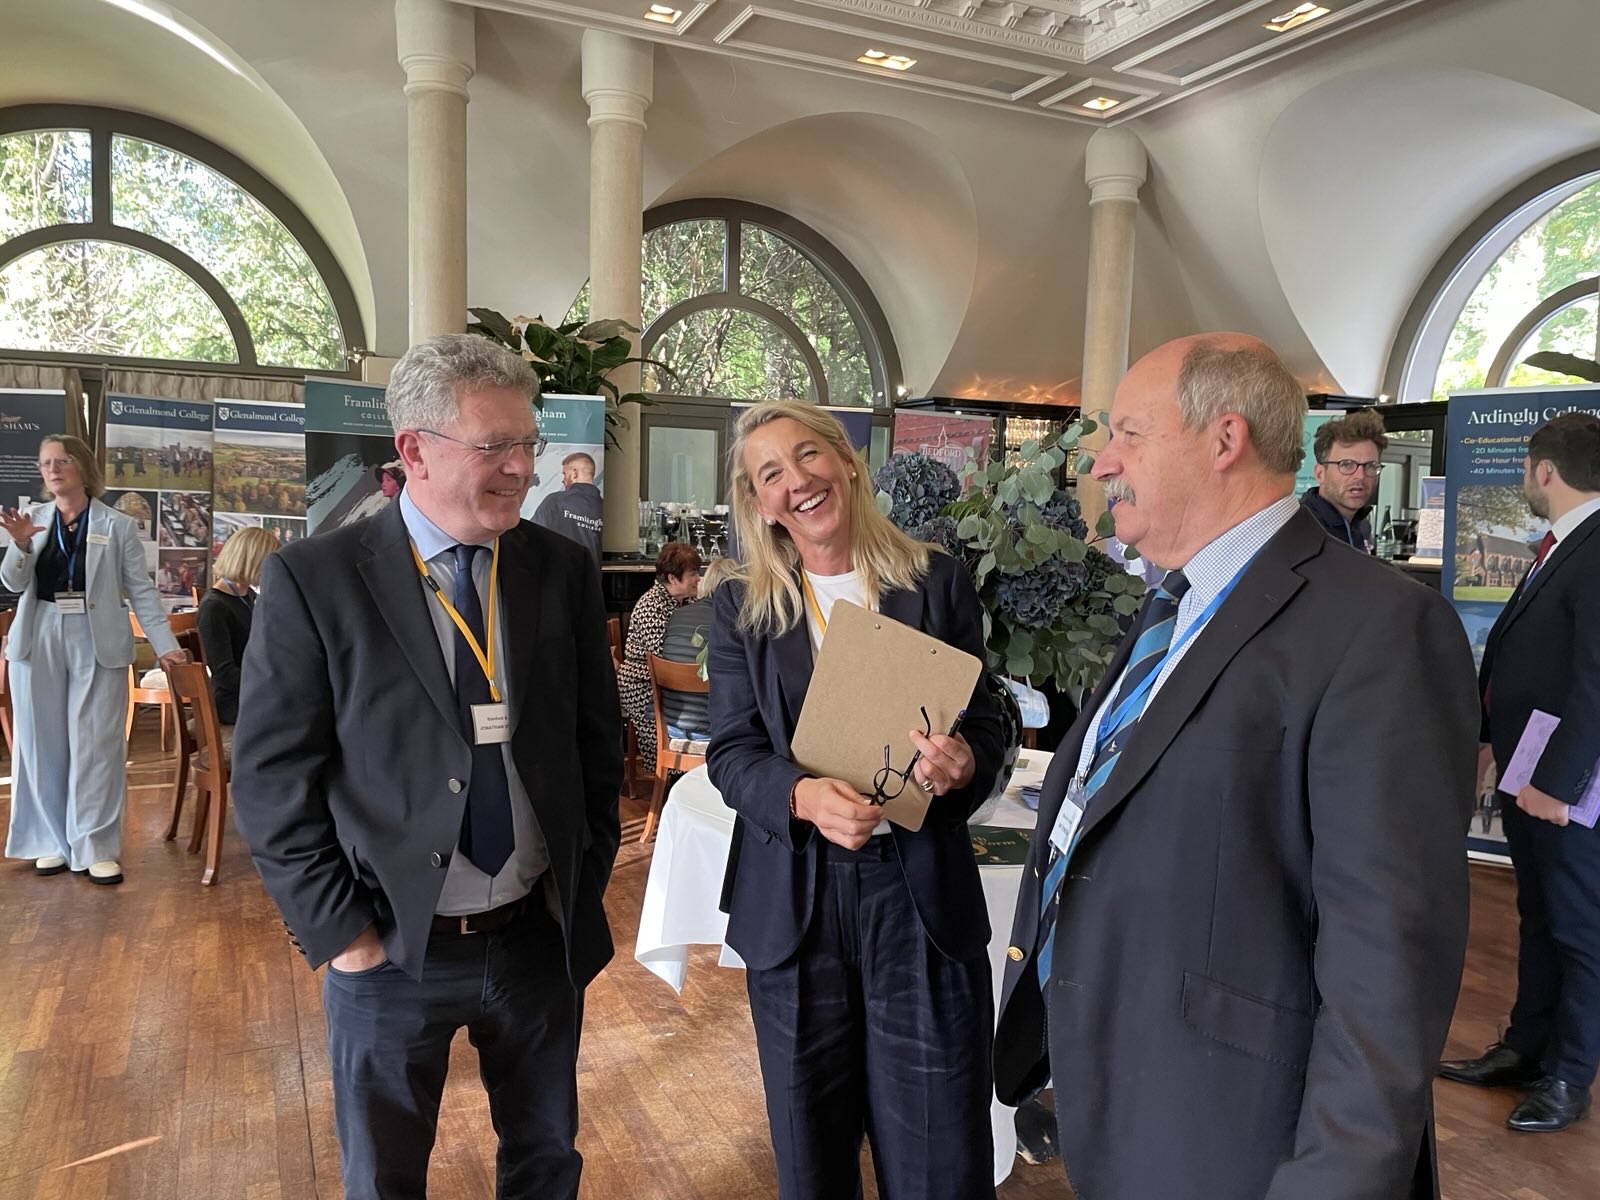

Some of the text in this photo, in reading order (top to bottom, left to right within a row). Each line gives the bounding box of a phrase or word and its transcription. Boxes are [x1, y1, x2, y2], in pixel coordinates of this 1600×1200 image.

[124, 404, 210, 422] Glenalmond College
[230, 410, 305, 425] Glenalmond Colleg
[1467, 408, 1539, 426] Ardingly
[1463, 434, 1522, 444] Co-Educational
[922, 447, 961, 457] BEDFORD
[1487, 446, 1517, 454] Minutes
[1474, 457, 1490, 465] One
[1492, 456, 1511, 464] Hour
[1486, 466, 1515, 474] Minutes
